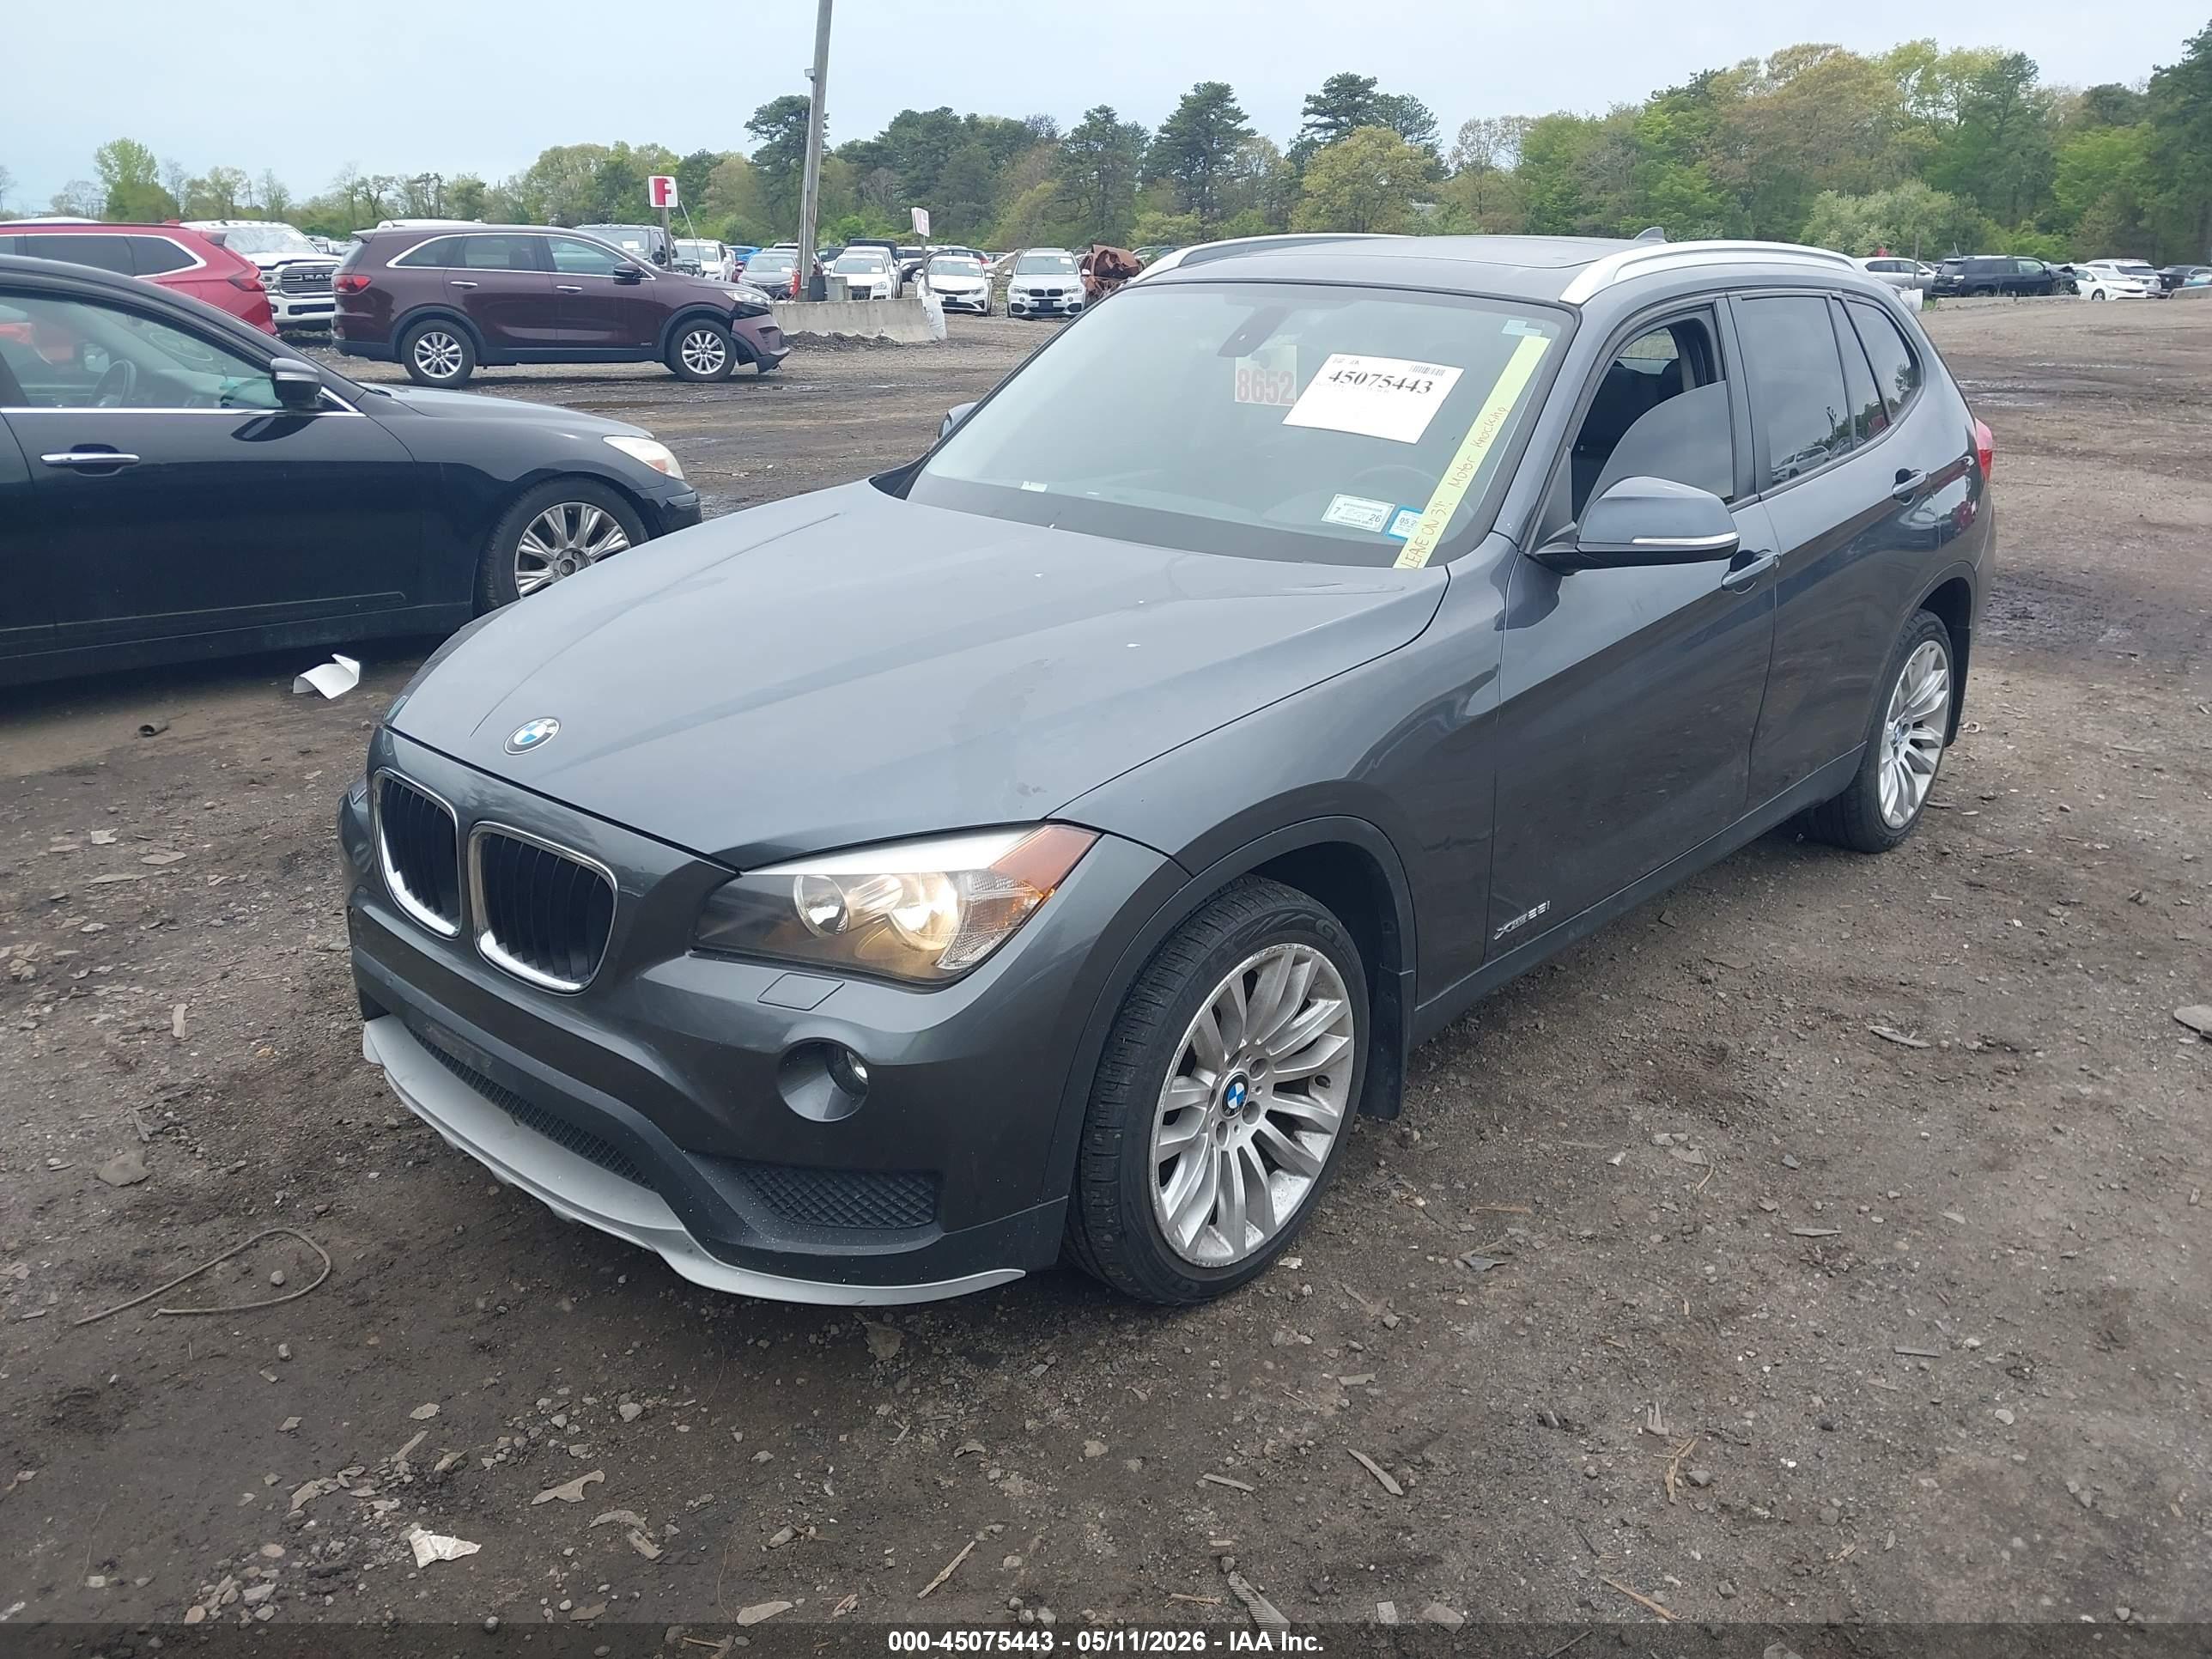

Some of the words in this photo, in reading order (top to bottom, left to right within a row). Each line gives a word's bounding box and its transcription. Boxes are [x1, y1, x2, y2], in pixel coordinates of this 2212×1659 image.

[653, 178, 671, 205] F
[1237, 368, 1295, 404] 8652
[1328, 369, 1433, 394] 45075443
[1369, 514, 1382, 523] 26
[1401, 536, 1429, 568] LEAVE
[1421, 519, 1440, 536] ON
[1448, 455, 1475, 489] Motor
